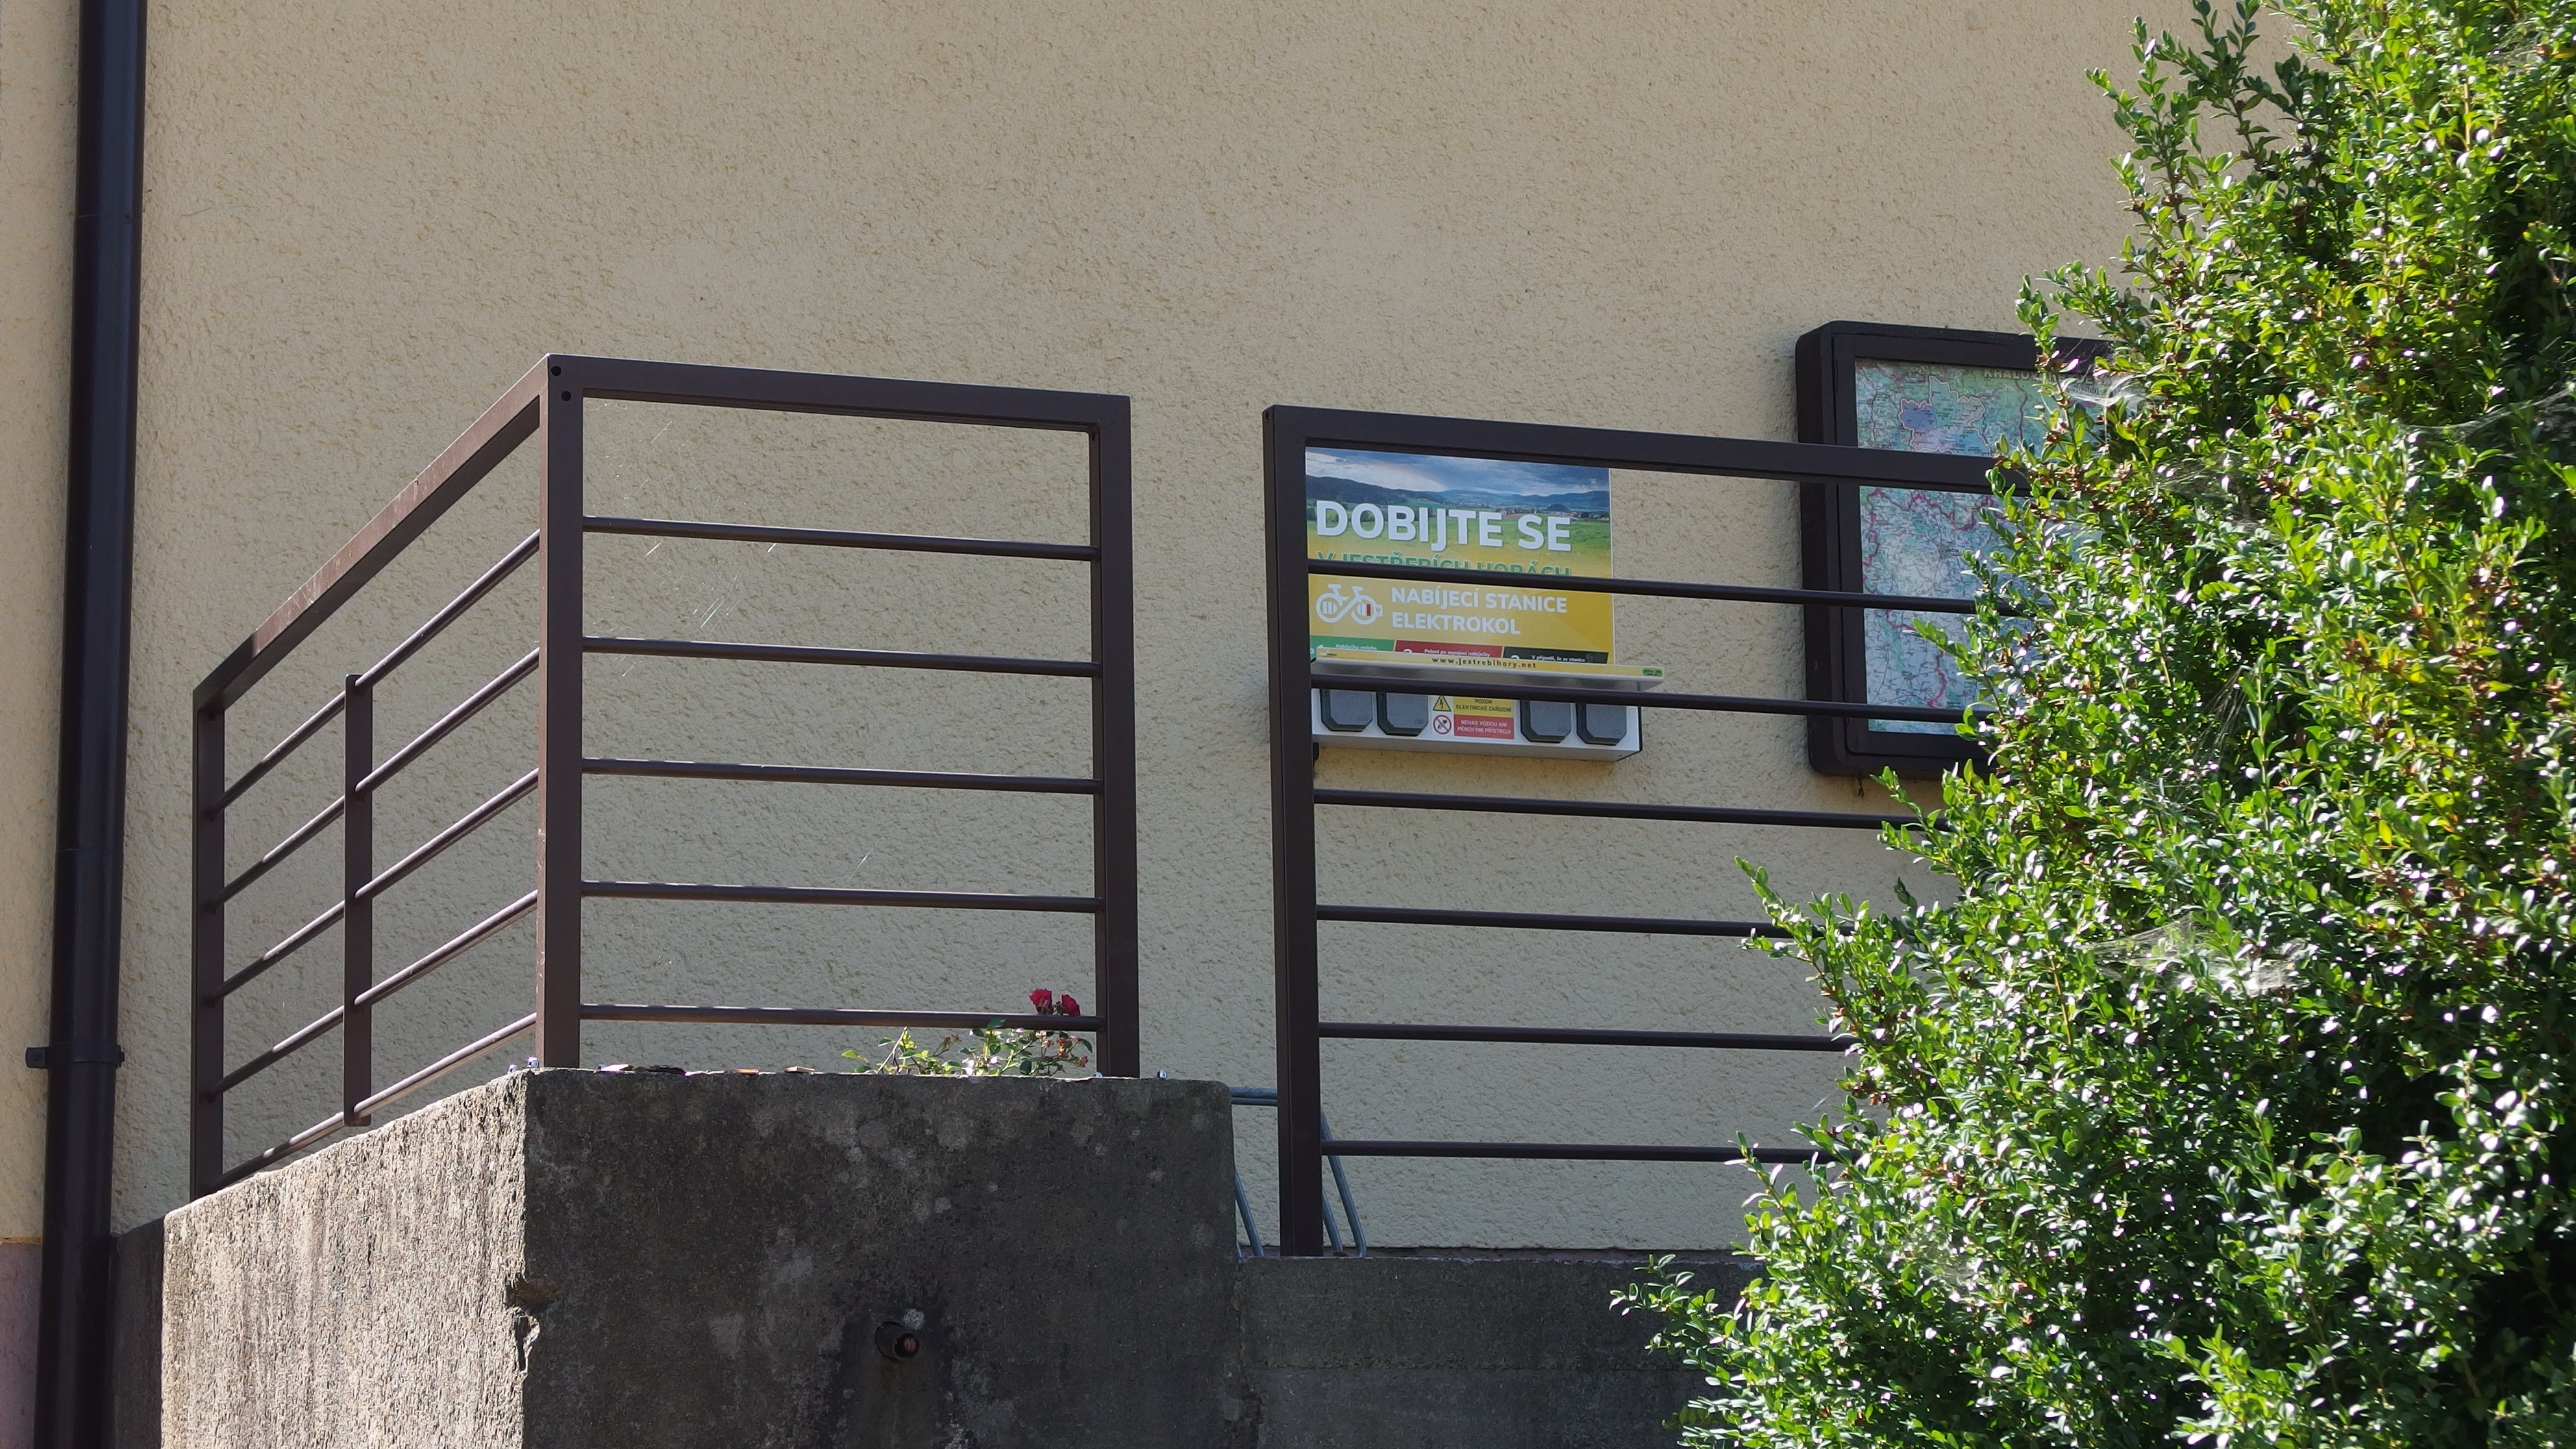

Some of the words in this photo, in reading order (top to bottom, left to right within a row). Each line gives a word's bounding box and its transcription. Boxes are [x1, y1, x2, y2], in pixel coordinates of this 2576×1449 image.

[1316, 500, 1503, 552] DOBIJTE
[1517, 514, 1571, 552] SE
[1391, 586, 1480, 610] NABÍJECÍ
[1485, 593, 1568, 613] STANICE
[1391, 612, 1522, 635] ELEKTROKOL
[1431, 657, 1537, 669] www.jestrebihory.net
